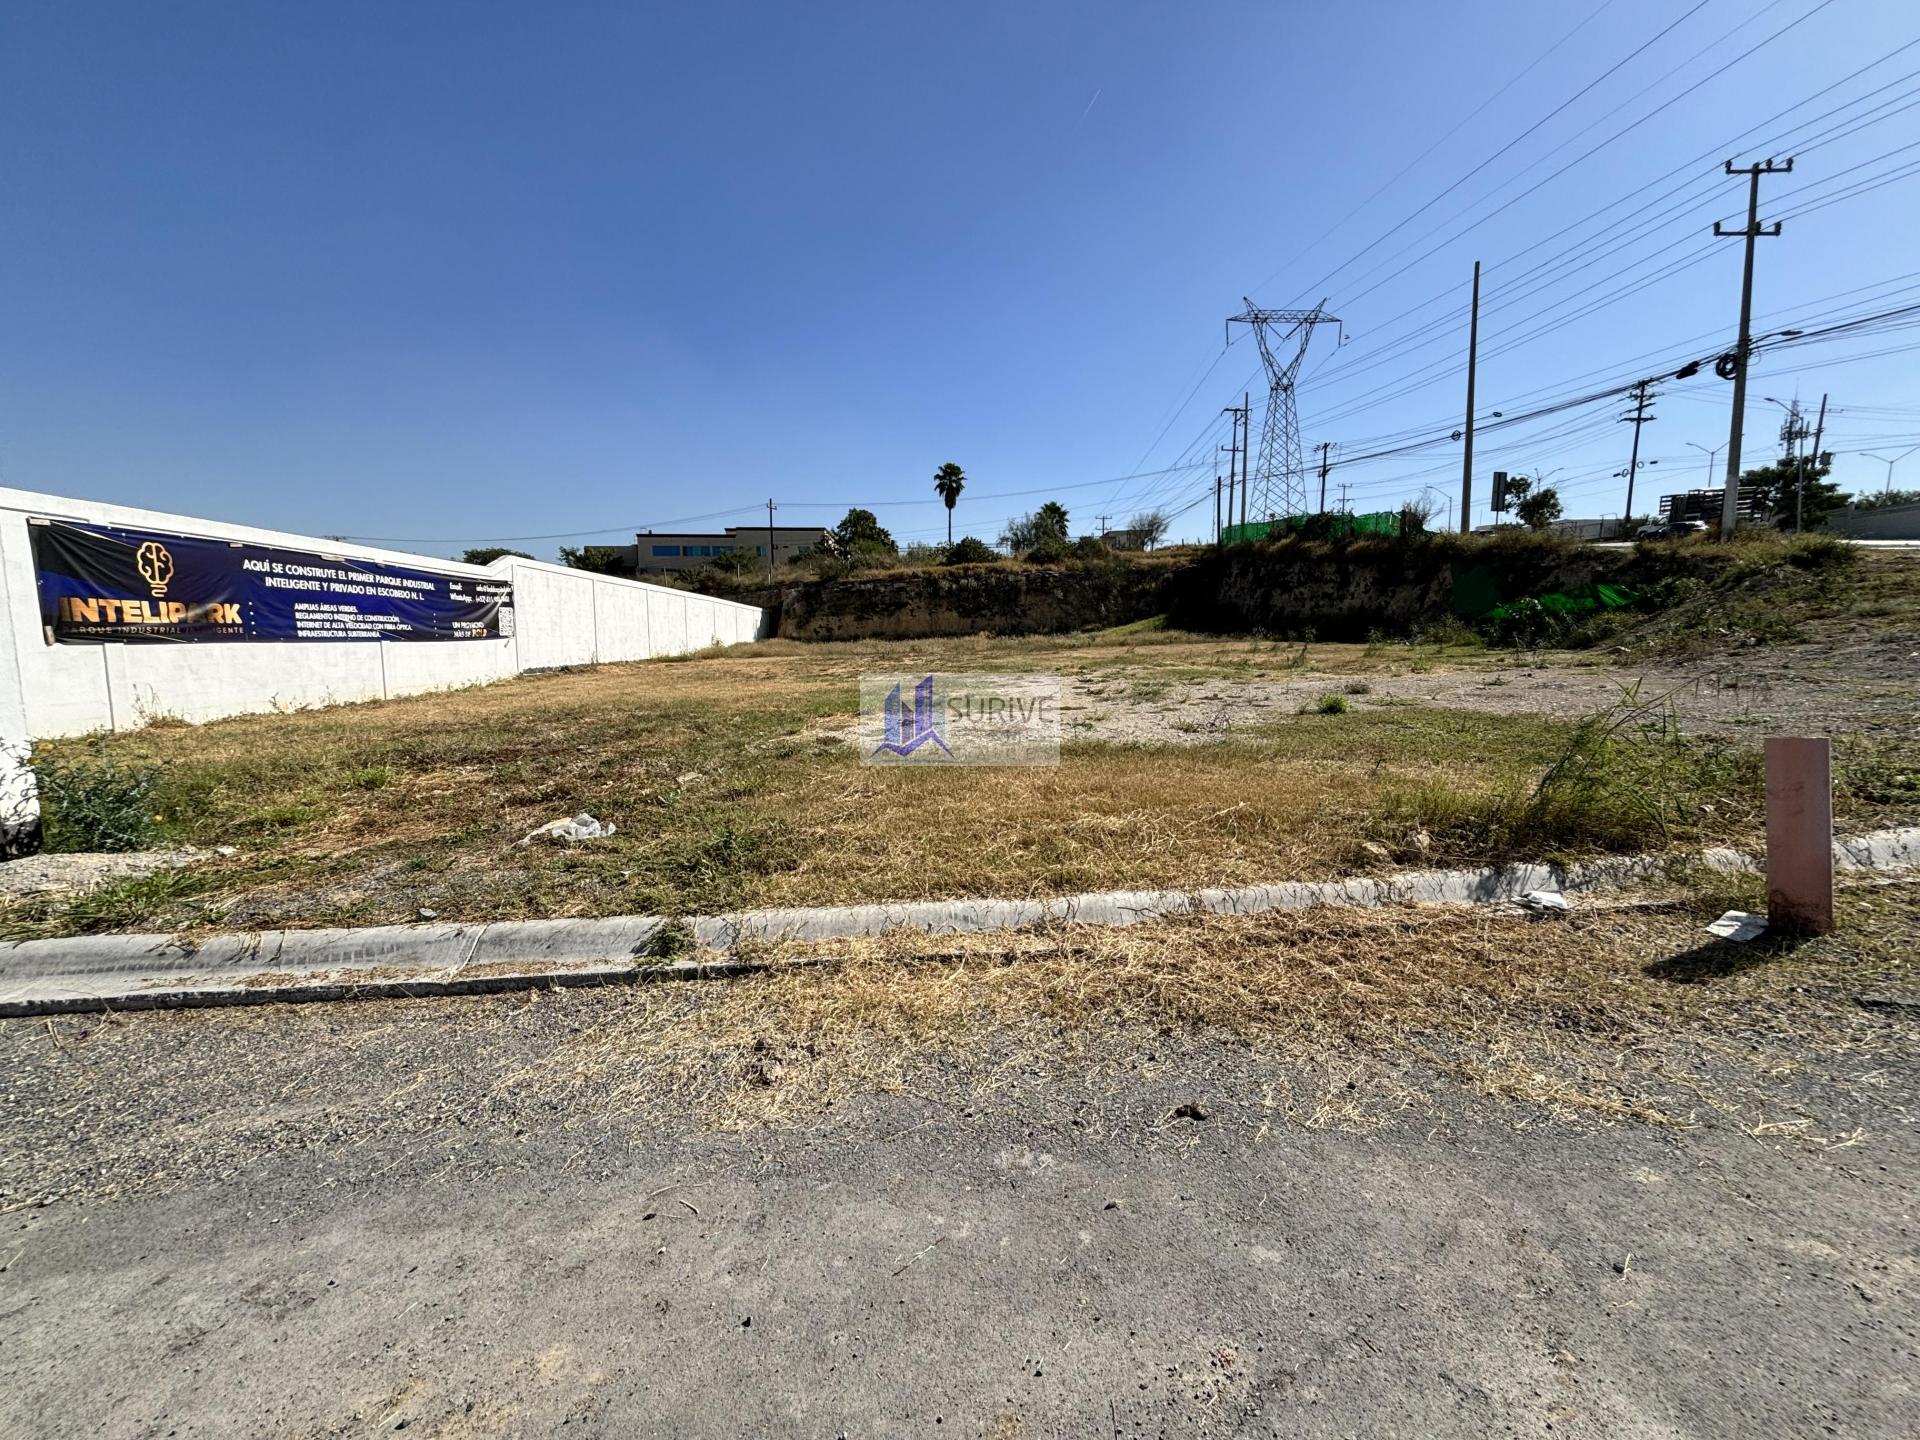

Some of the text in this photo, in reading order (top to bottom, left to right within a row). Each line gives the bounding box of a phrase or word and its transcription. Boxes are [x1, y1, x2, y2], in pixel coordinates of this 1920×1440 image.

[272, 563, 283, 573] SE
[285, 564, 336, 578] CONSTRUYE
[338, 570, 347, 580] EL
[348, 571, 374, 583] PRIMER
[375, 575, 402, 586] PARQUE
[402, 578, 435, 590] INDUSTRIAL
[265, 576, 321, 591] INTELIGENTE
[321, 582, 328, 591] Y
[330, 583, 365, 594] PRIVADO
[366, 586, 376, 595] EN
[378, 587, 410, 599] ESCOBEDO
[59, 596, 242, 624] INTELIPARK
[295, 611, 333, 620] REGLAMENTO
[357, 614, 363, 622] DE
[118, 626, 182, 634] INDUSTRIAL
[323, 621, 331, 629] DE
[332, 621, 345, 629] ALTA
